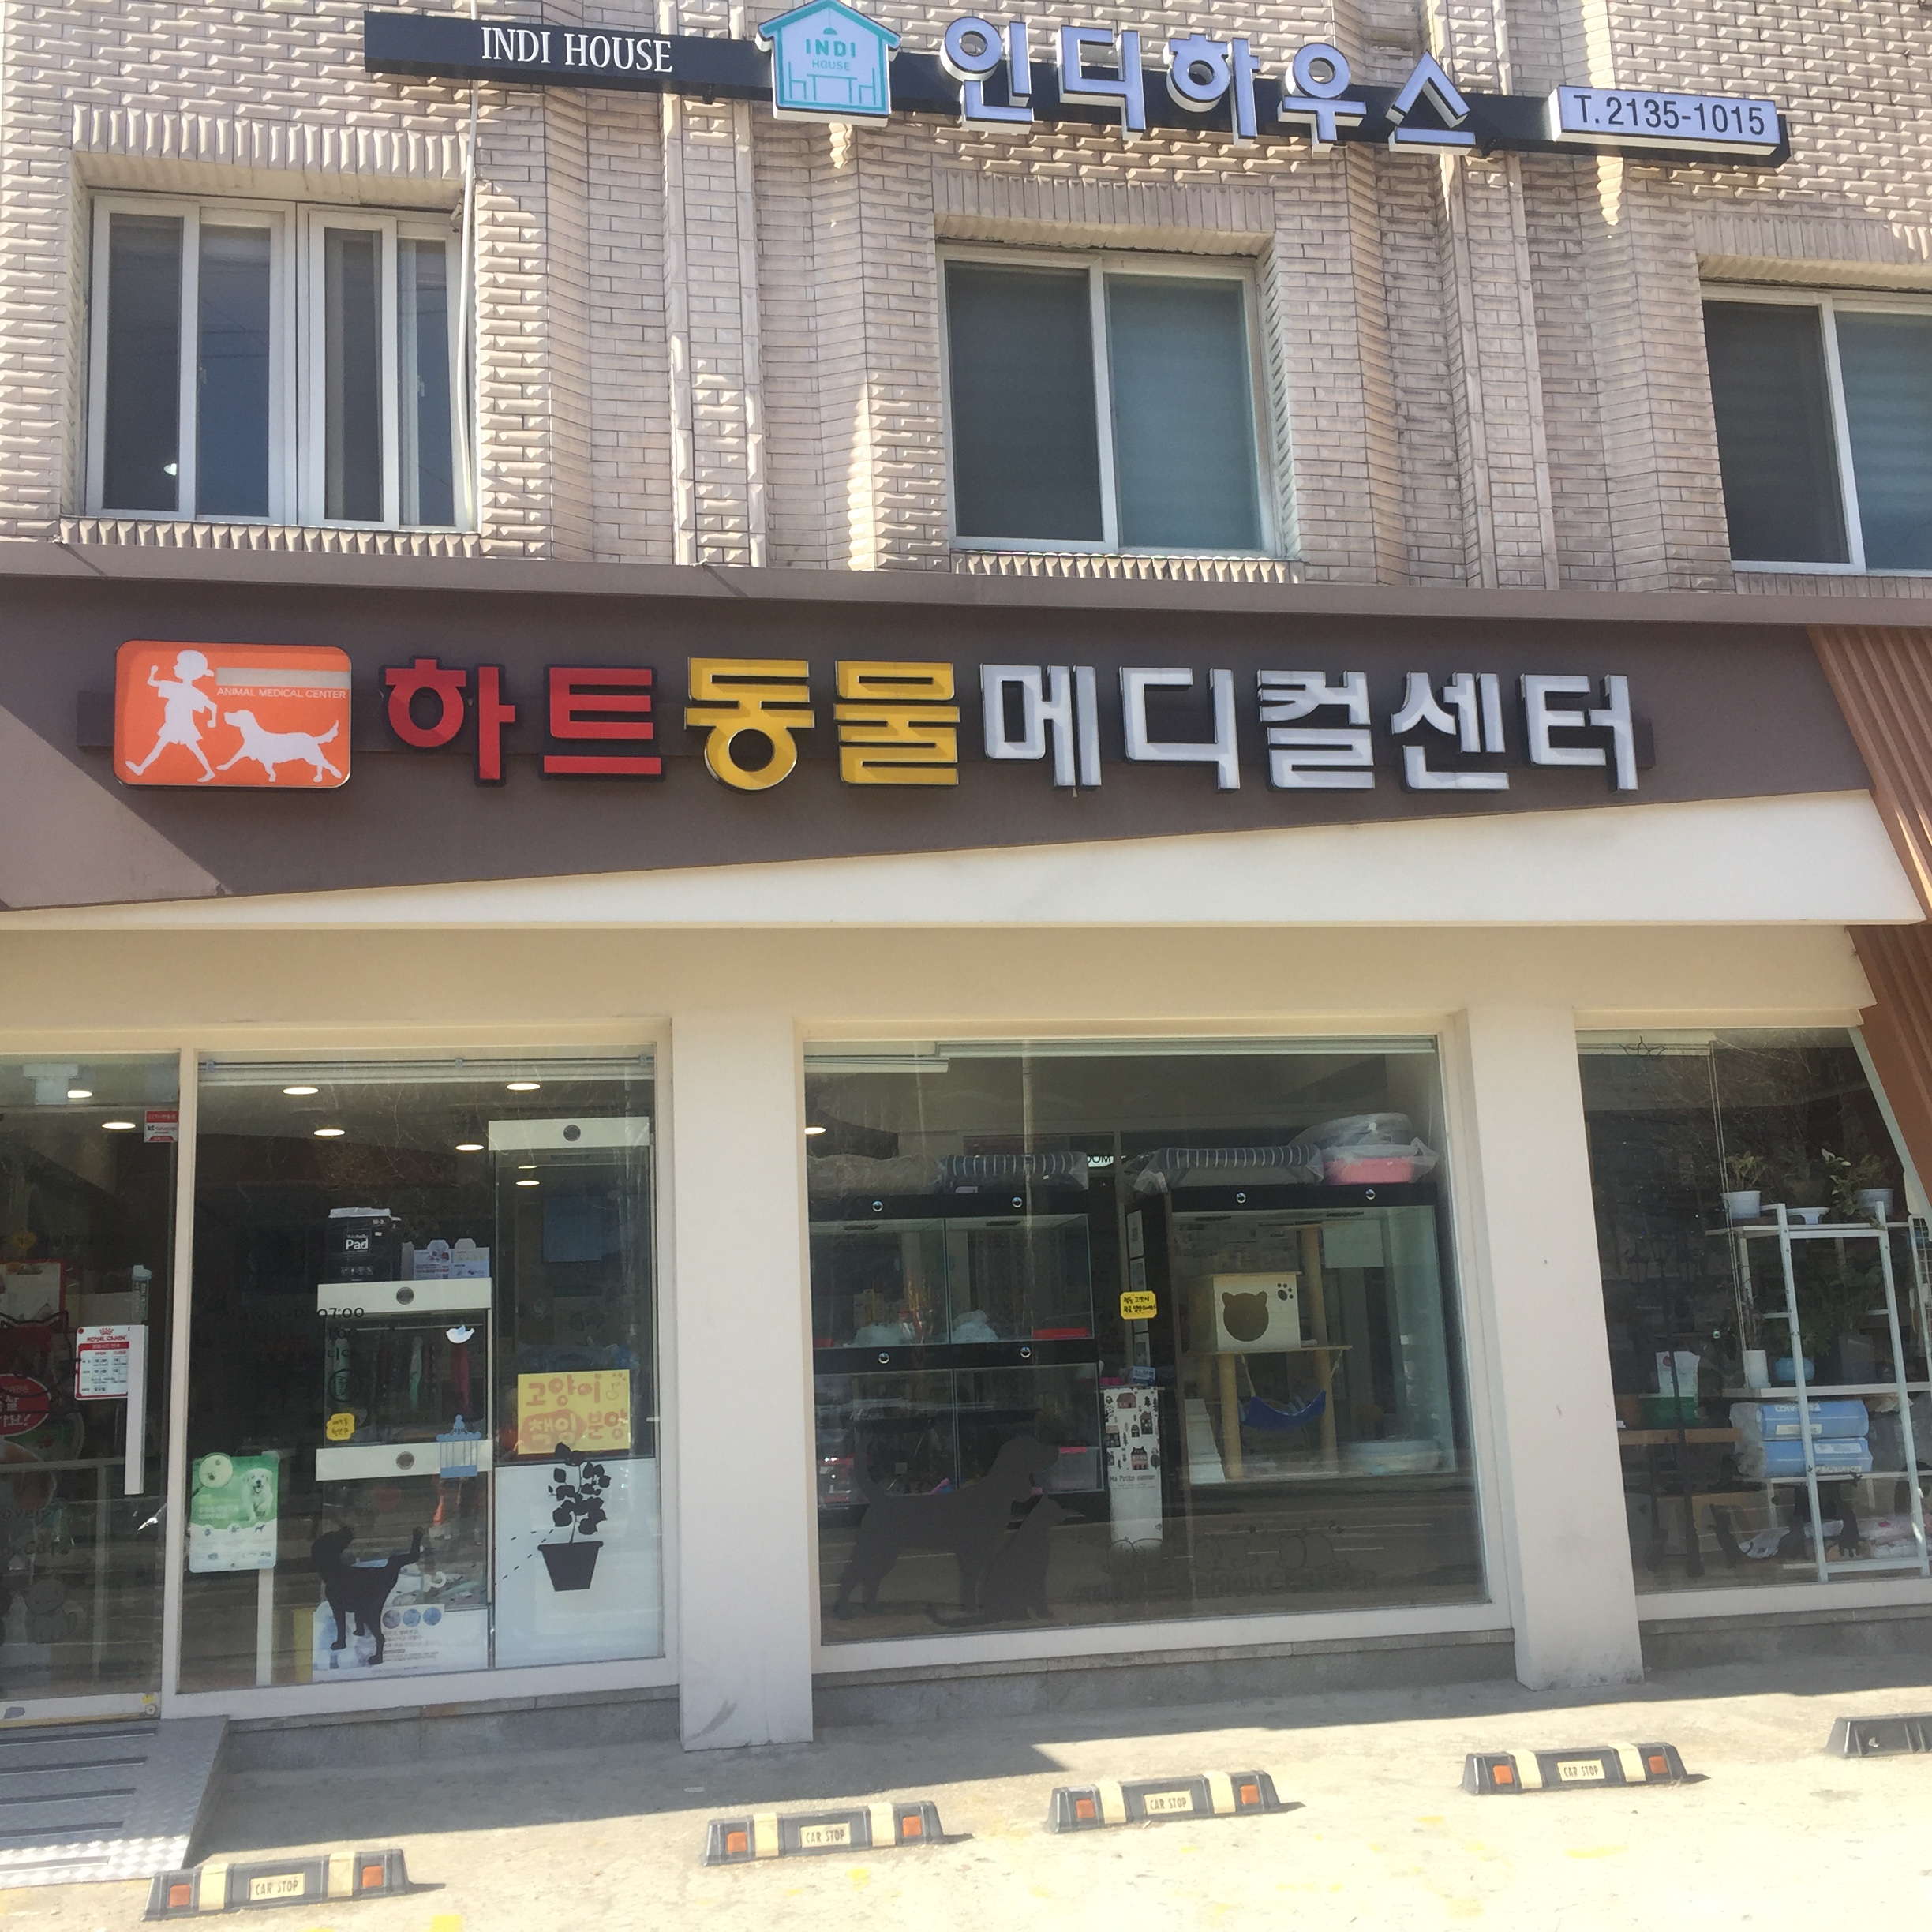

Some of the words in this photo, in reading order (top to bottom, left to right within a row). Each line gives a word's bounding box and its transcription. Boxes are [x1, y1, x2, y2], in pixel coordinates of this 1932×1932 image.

[481, 26, 551, 65] INDI
[564, 33, 674, 73] HOUSE
[806, 39, 856, 58] INDI
[811, 59, 850, 71] HOUSE
[942, 16, 1476, 148] 인디하우스
[1574, 93, 1765, 136] T.2135-1015
[217, 687, 256, 697] ANIMAL
[258, 688, 304, 698] MEDICAL
[305, 689, 346, 699] CENTER
[345, 1238, 369, 1250] Pad
[317, 1307, 365, 1320] 07:00
[526, 1373, 602, 1406] 고양이
[588, 1408, 628, 1440] 분양
[1563, 1766, 1578, 1777] CAR
[1581, 1765, 1599, 1777] STOP
[1150, 1799, 1165, 1810] CAR
[1168, 1797, 1187, 1809] STOP
[806, 1831, 821, 1844] CAR
[826, 1829, 844, 1842] STOP
[255, 1882, 272, 1895] CAR
[277, 1879, 298, 1893] STOP
